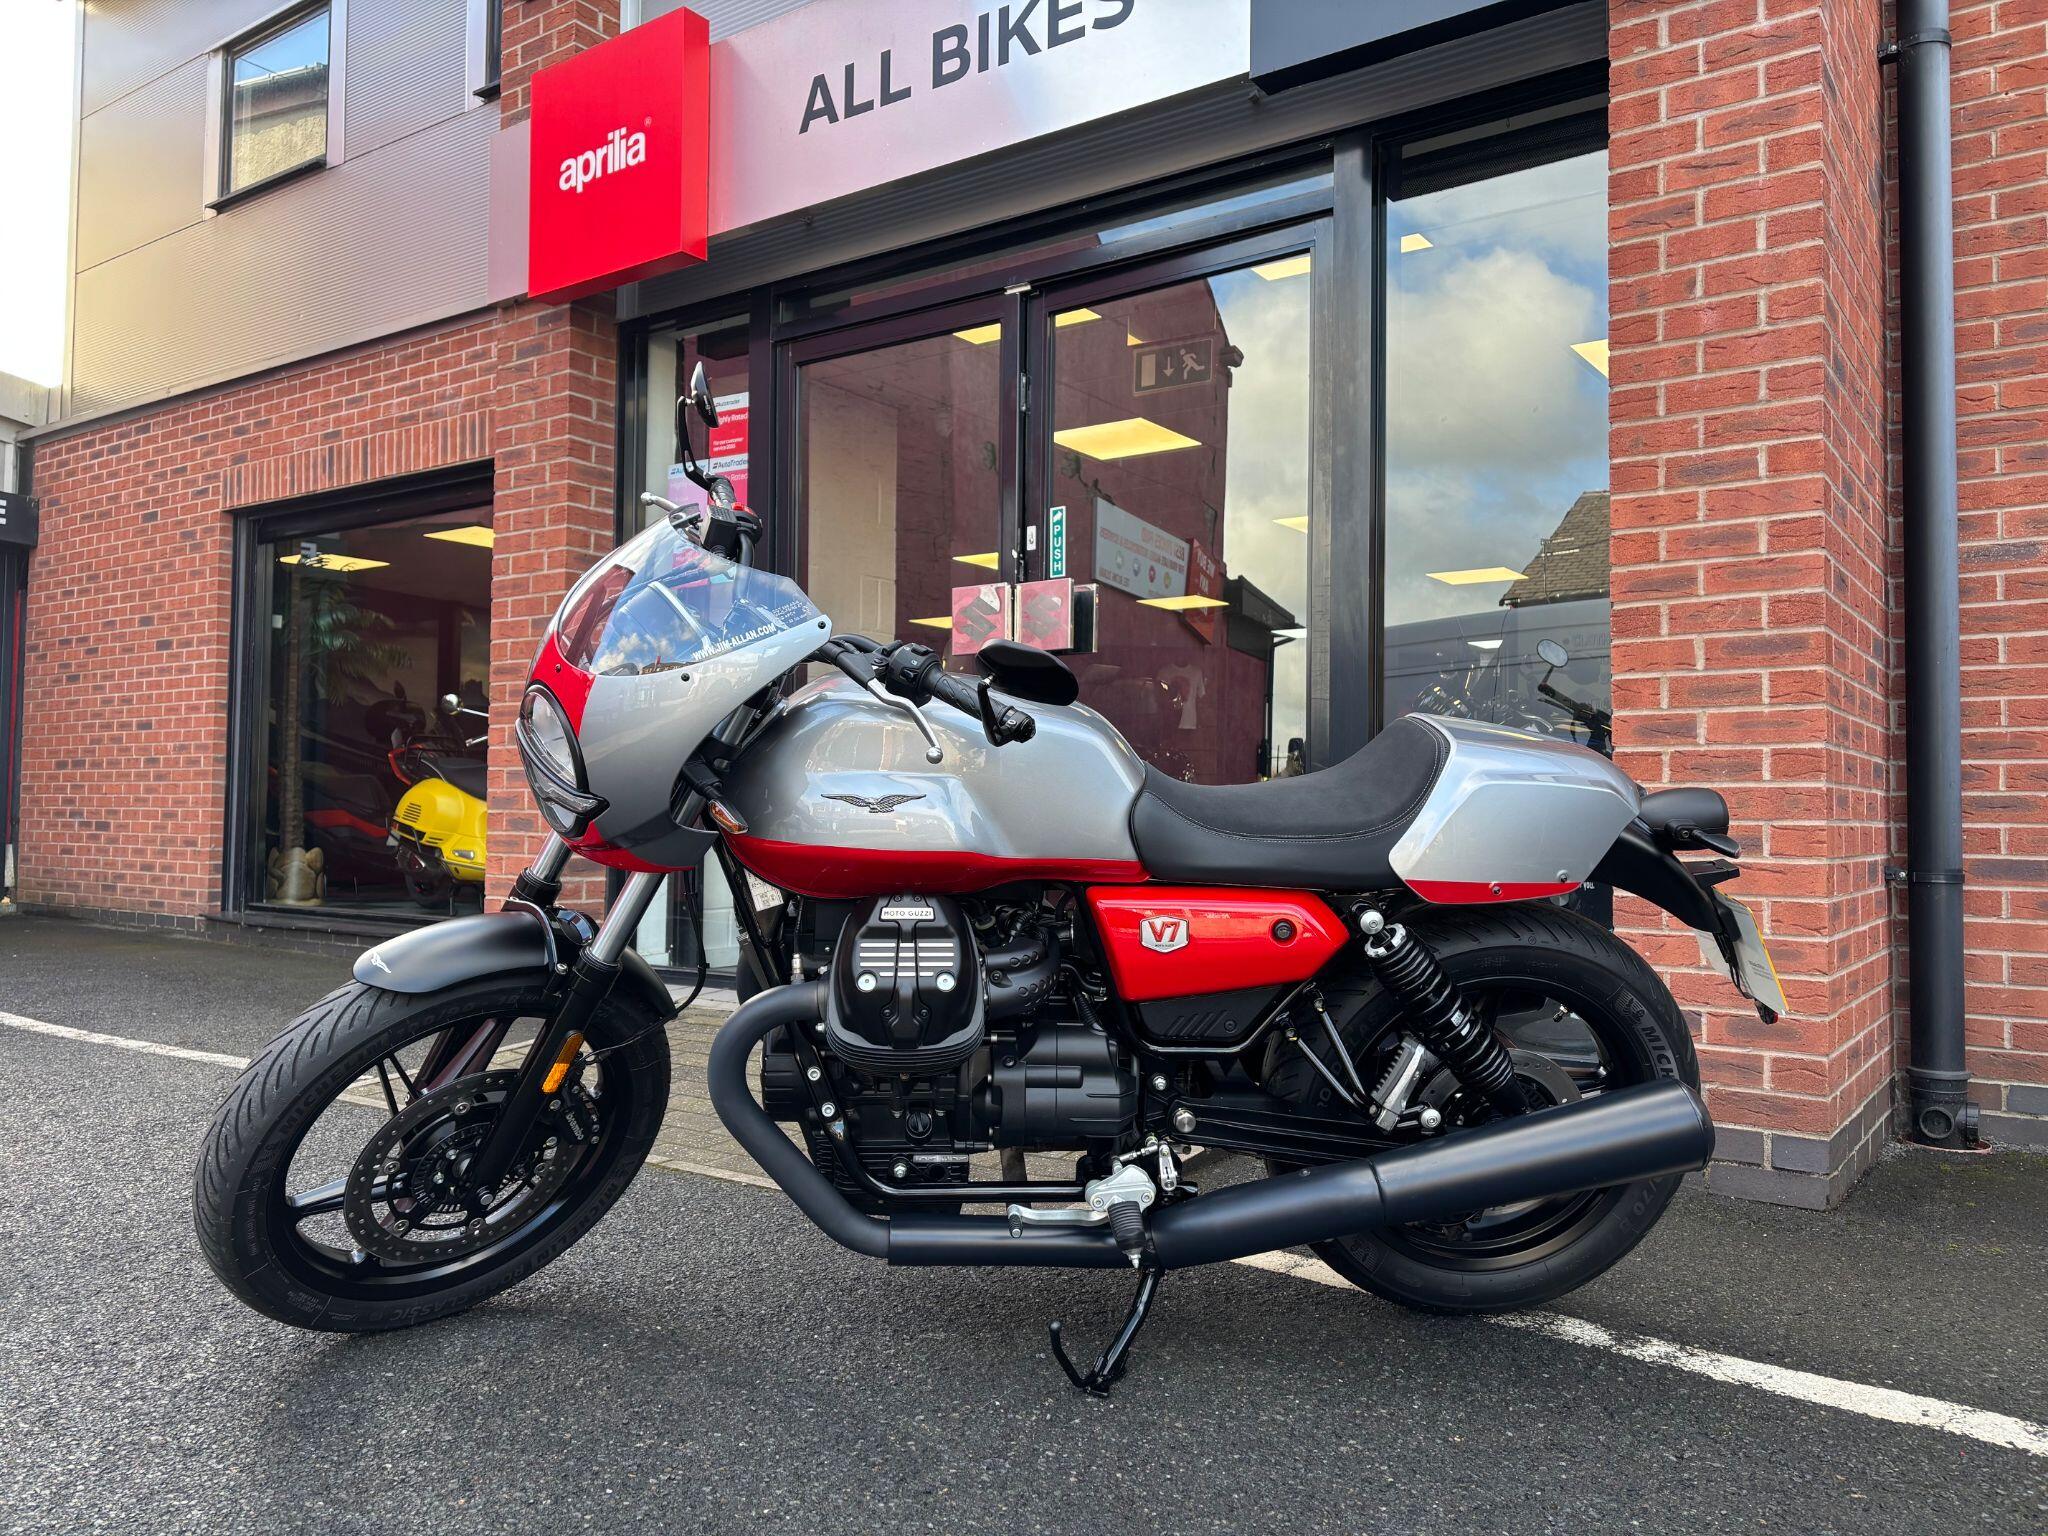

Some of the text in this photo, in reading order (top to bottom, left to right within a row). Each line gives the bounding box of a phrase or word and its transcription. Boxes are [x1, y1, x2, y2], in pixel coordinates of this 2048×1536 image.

[799, 48, 911, 134] ALL
[559, 127, 646, 194] aprilia
[1053, 524, 1062, 572] PUSH
[692, 622, 778, 661] WWW.JIM-ALLAN.COM
[1148, 920, 1181, 943] V7
[1640, 1026, 1677, 1080] MICH
